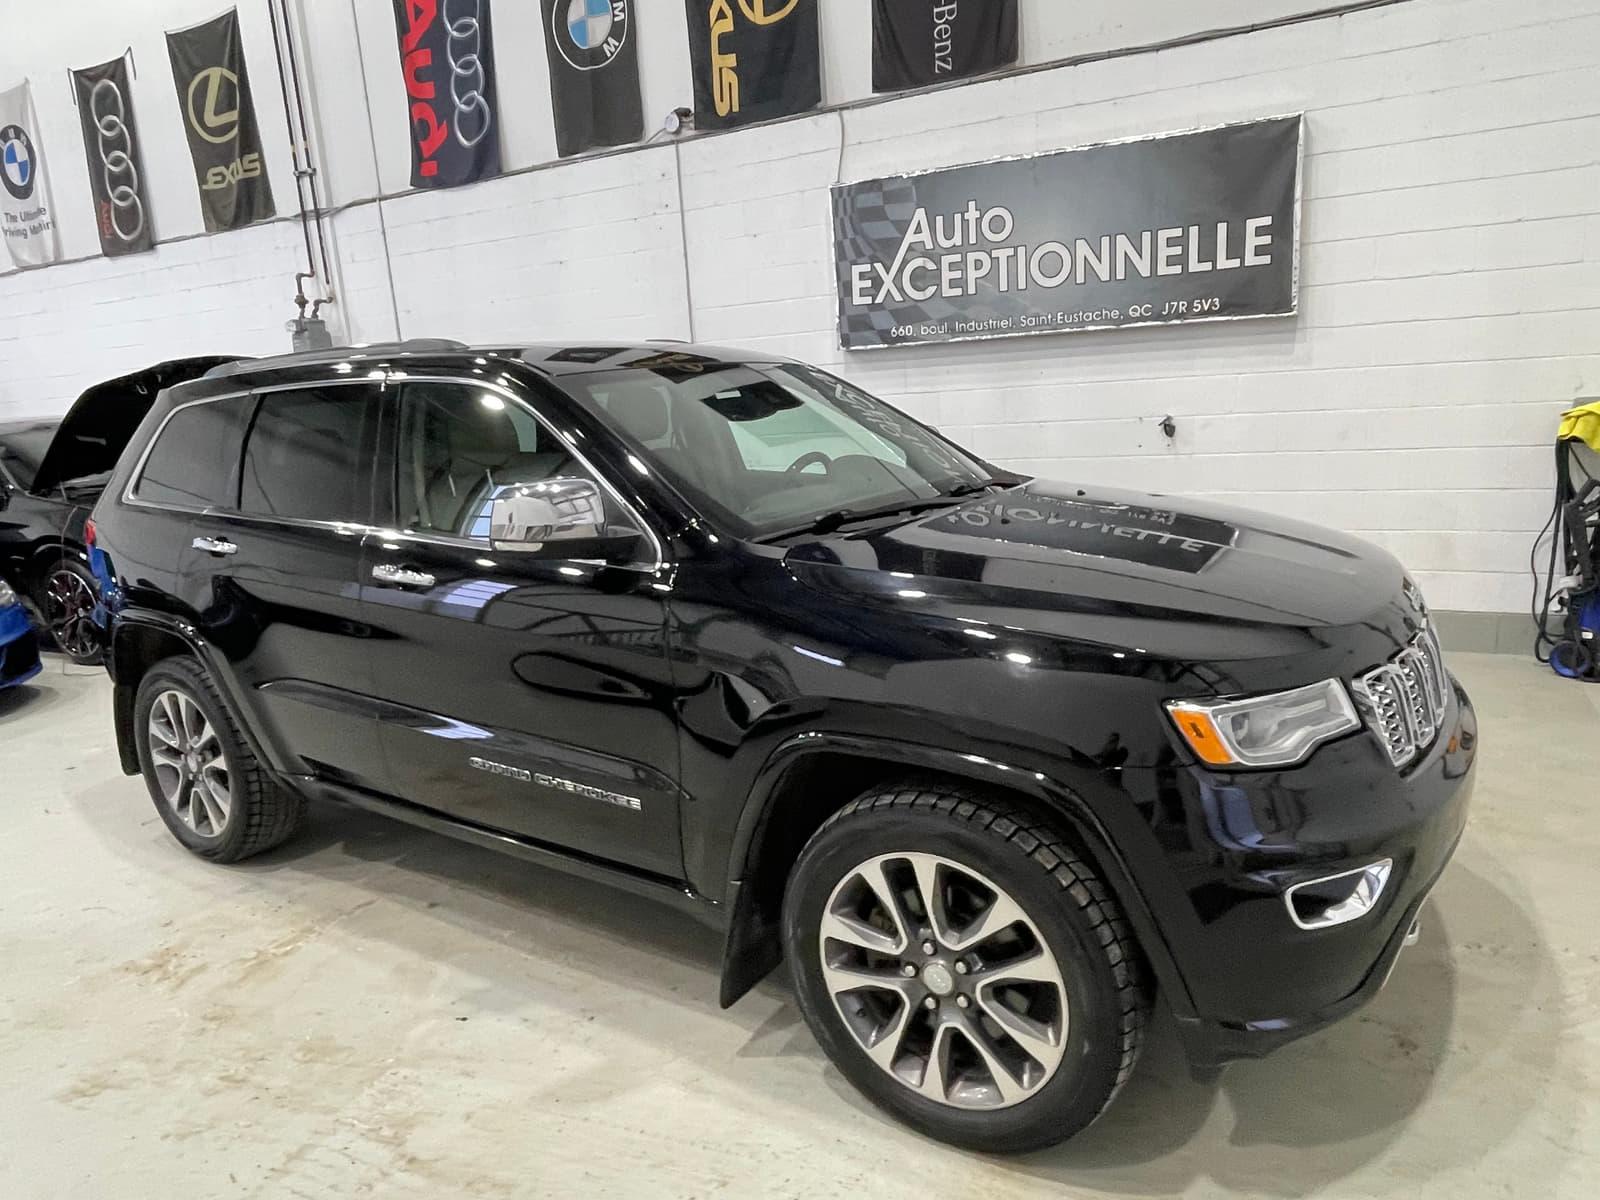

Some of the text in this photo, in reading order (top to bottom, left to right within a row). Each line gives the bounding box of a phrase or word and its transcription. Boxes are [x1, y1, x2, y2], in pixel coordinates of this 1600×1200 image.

[904, 200, 1015, 251] Auto
[851, 215, 1274, 306] EXCEPTIONNELLE
[1129, 303, 1153, 318] QC
[1162, 300, 1188, 316] J7R
[1193, 297, 1221, 312] 5V3
